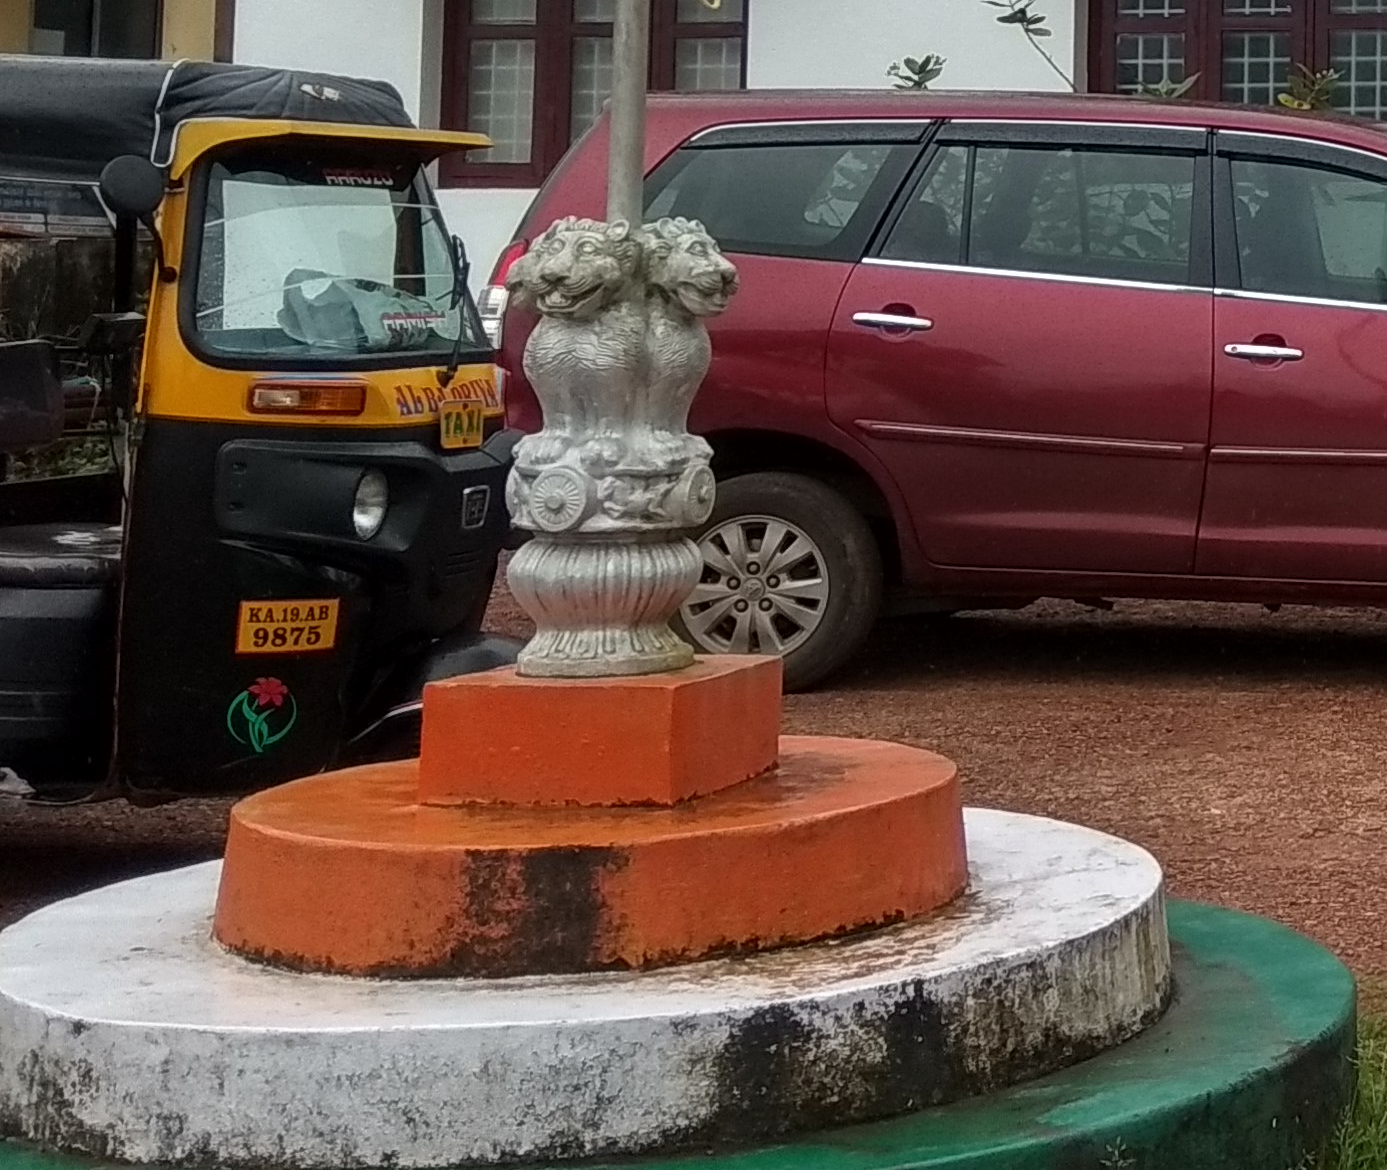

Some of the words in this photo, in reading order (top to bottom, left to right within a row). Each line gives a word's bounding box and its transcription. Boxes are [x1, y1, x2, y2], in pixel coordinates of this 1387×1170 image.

[395, 384, 424, 416] AL
[444, 408, 481, 437] TAXI
[247, 605, 331, 624] KA.19.AB
[252, 625, 322, 648] 9875
